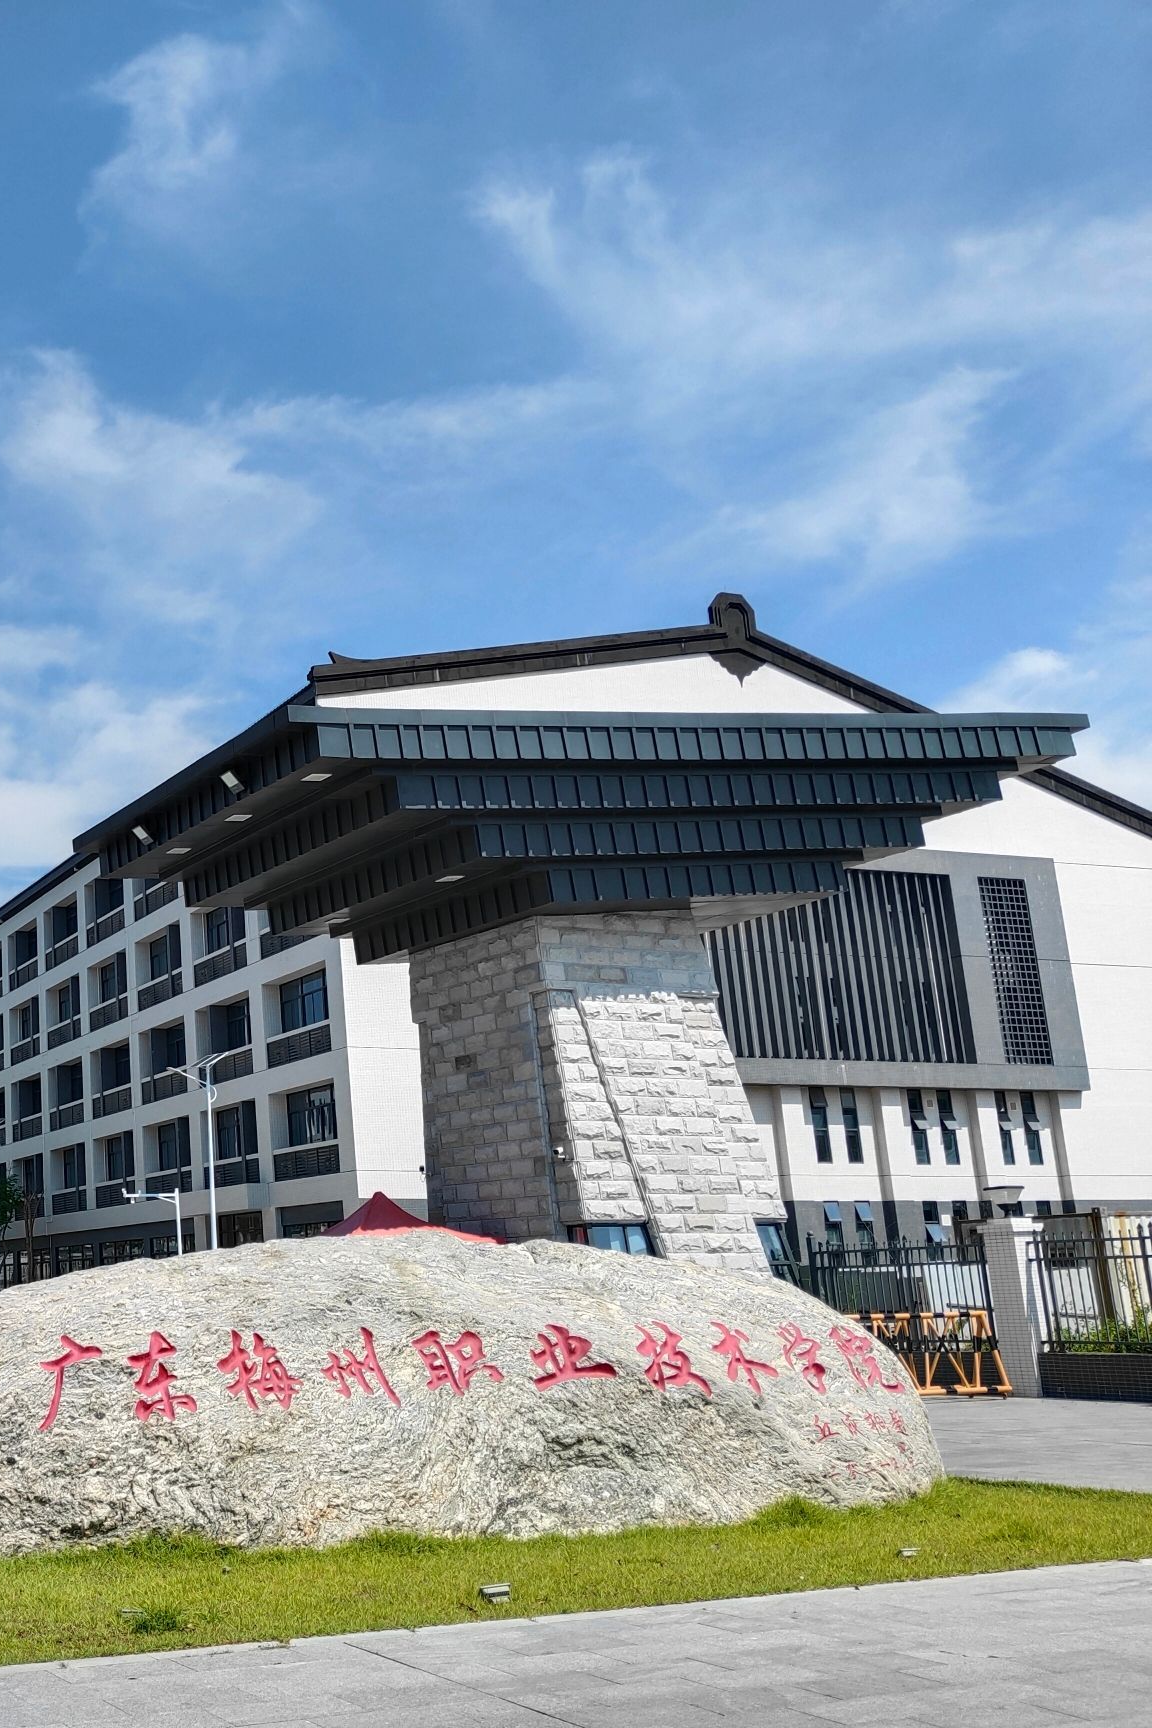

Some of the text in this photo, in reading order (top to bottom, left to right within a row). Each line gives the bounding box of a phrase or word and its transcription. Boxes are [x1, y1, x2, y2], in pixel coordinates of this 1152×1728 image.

[39, 1321, 906, 1431] 广东梅州职业技术学院
